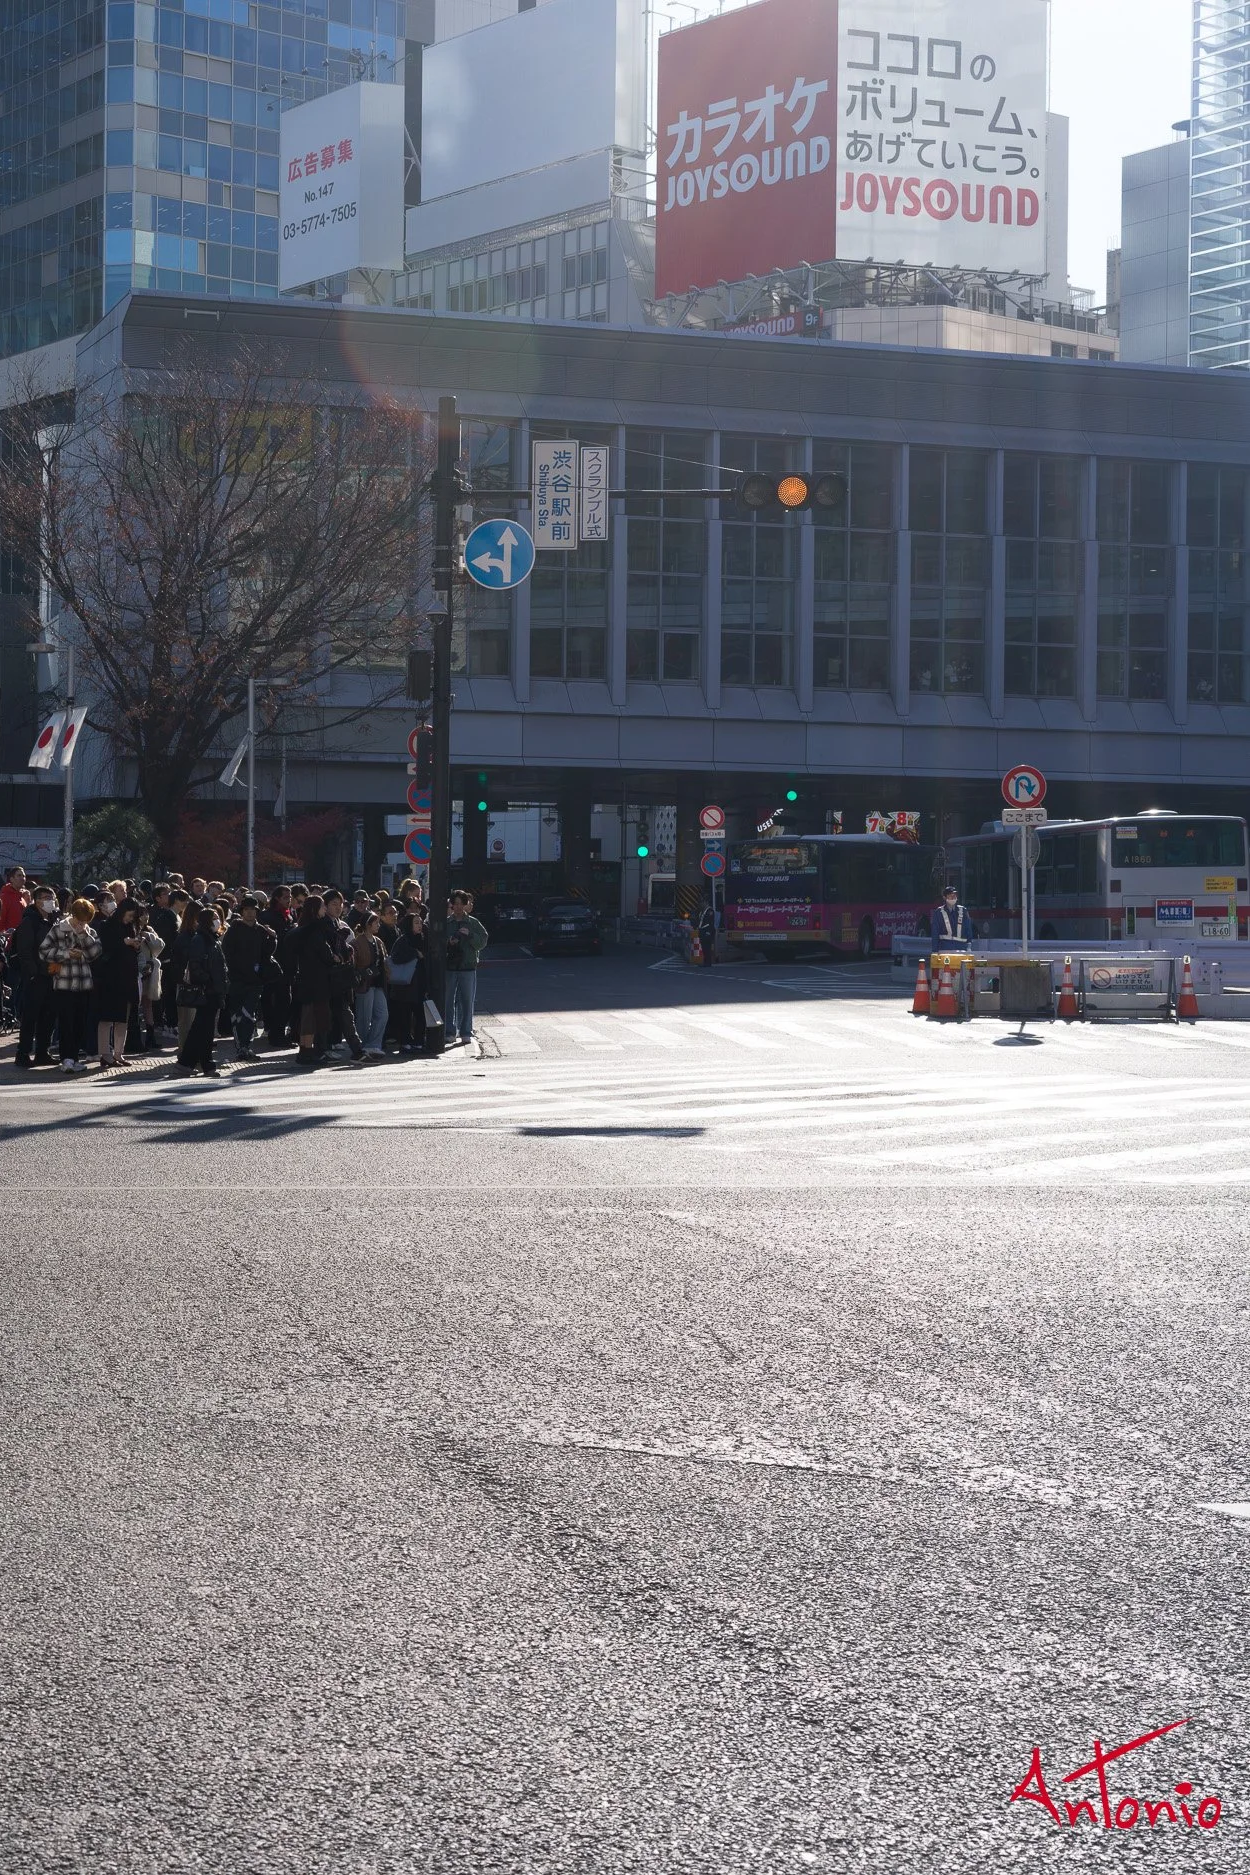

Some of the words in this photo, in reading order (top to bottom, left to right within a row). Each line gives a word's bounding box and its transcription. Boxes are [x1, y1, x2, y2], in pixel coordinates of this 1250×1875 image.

[846, 28, 997, 83] ココロの
[665, 76, 828, 169] カラオケ
[845, 77, 1038, 139] ボリューム、
[287, 138, 353, 183] 広告募集
[664, 134, 831, 212] JOYSOUND
[844, 129, 1040, 179] あげていこう。
[304, 182, 335, 204] No.147
[839, 171, 1039, 227] JOYSOUND
[283, 201, 357, 241] 03-5774-7505
[805, 312, 819, 326] 9F
[536, 463, 550, 506] Shibuya
[551, 449, 572, 541] 渋谷駅前
[586, 451, 603, 537] スクランブル式
[538, 509, 549, 530] Sta.
[1005, 812, 1044, 823] ここまで
[1158, 907, 1191, 916] MIBU
